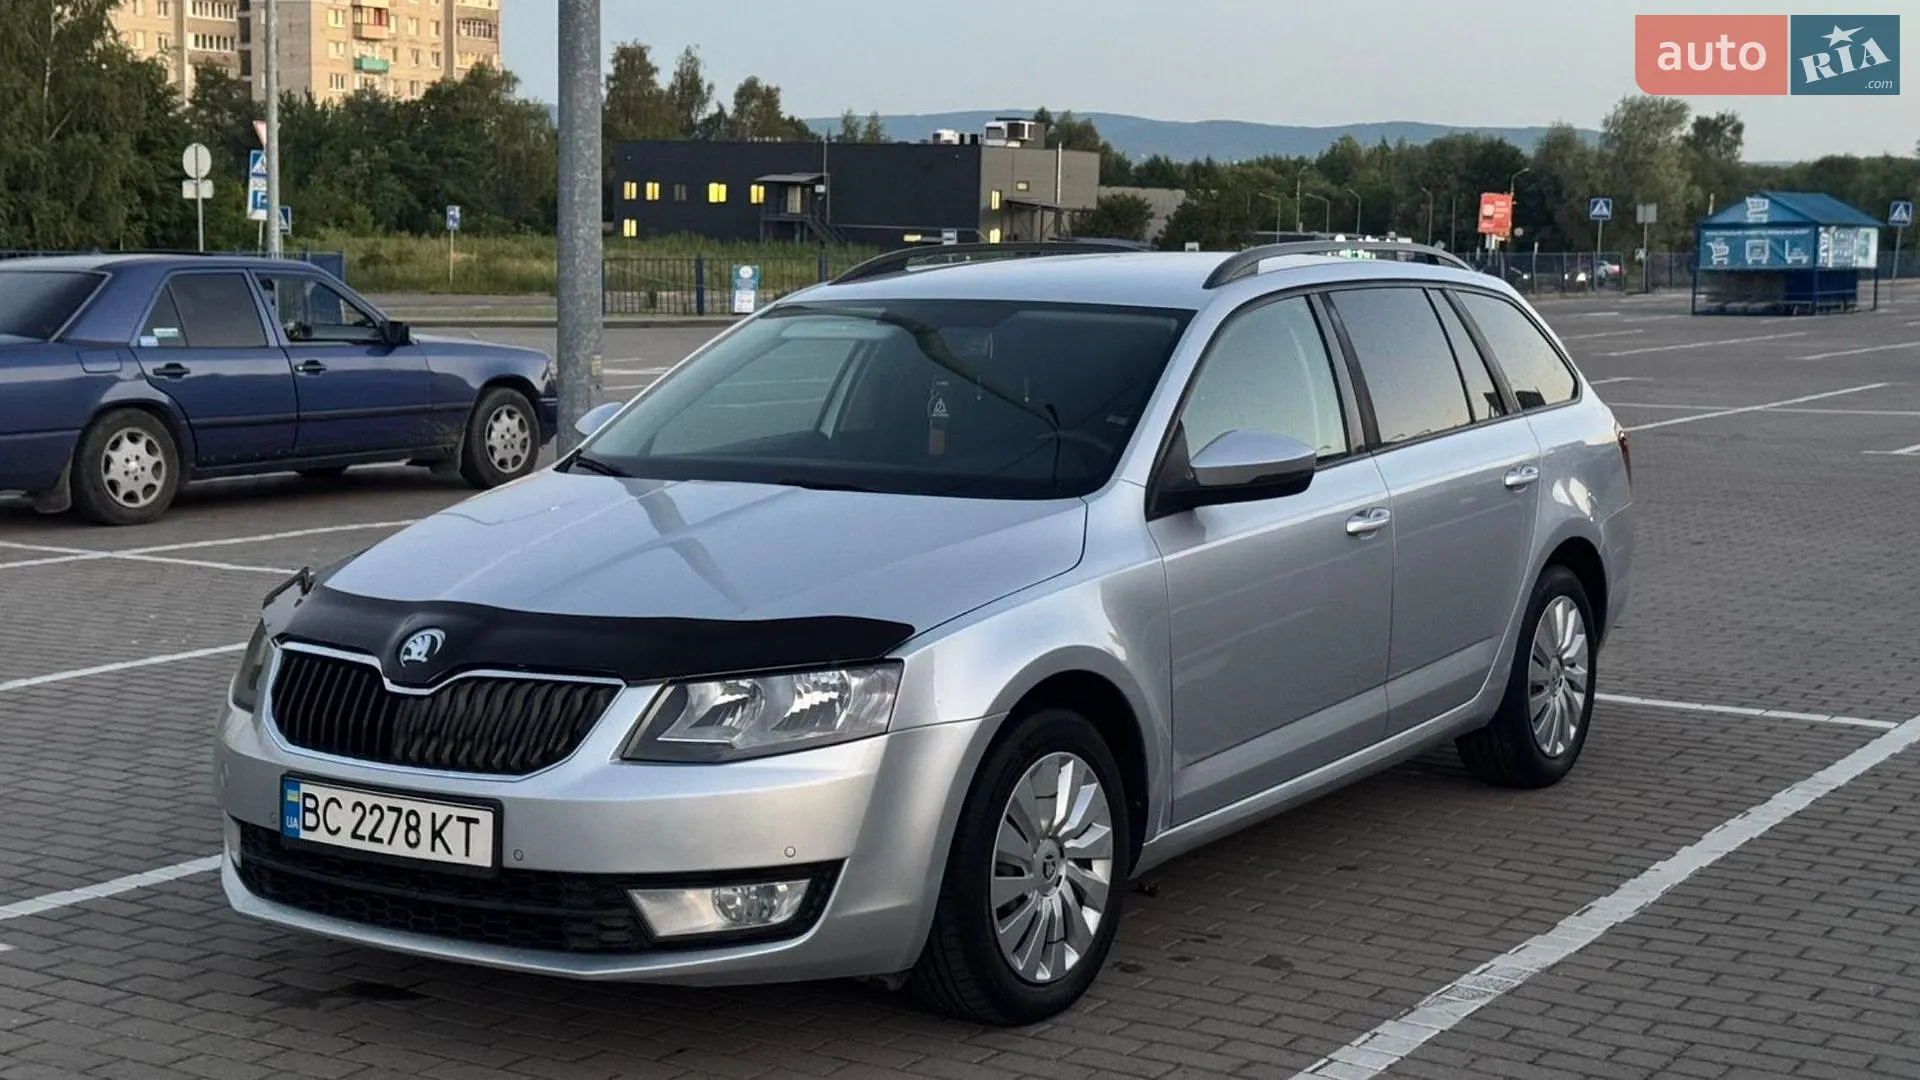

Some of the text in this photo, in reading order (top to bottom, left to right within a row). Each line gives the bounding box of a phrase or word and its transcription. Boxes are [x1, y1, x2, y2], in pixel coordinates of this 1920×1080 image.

[286, 815, 299, 830] UA
[302, 792, 480, 857] BC 2278 KT
